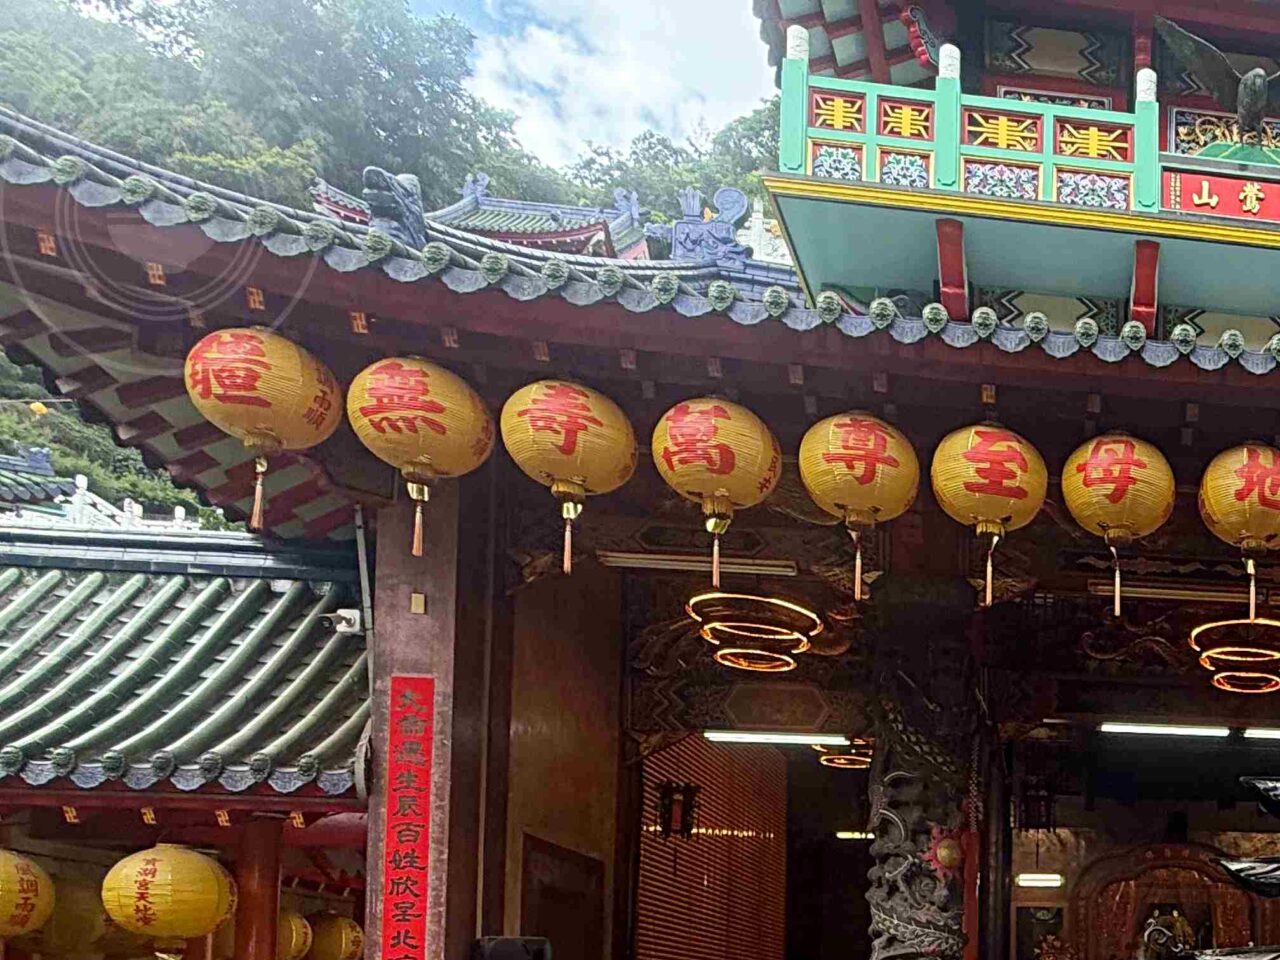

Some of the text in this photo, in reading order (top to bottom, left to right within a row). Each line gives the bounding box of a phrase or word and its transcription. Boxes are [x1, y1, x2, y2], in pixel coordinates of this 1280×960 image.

[189, 333, 272, 408] 疆
[359, 362, 448, 435] 無
[518, 384, 603, 456] 壽
[661, 404, 736, 475] 萬
[822, 418, 899, 485] 尊
[962, 429, 1028, 499] 至
[1076, 439, 1147, 504] 母
